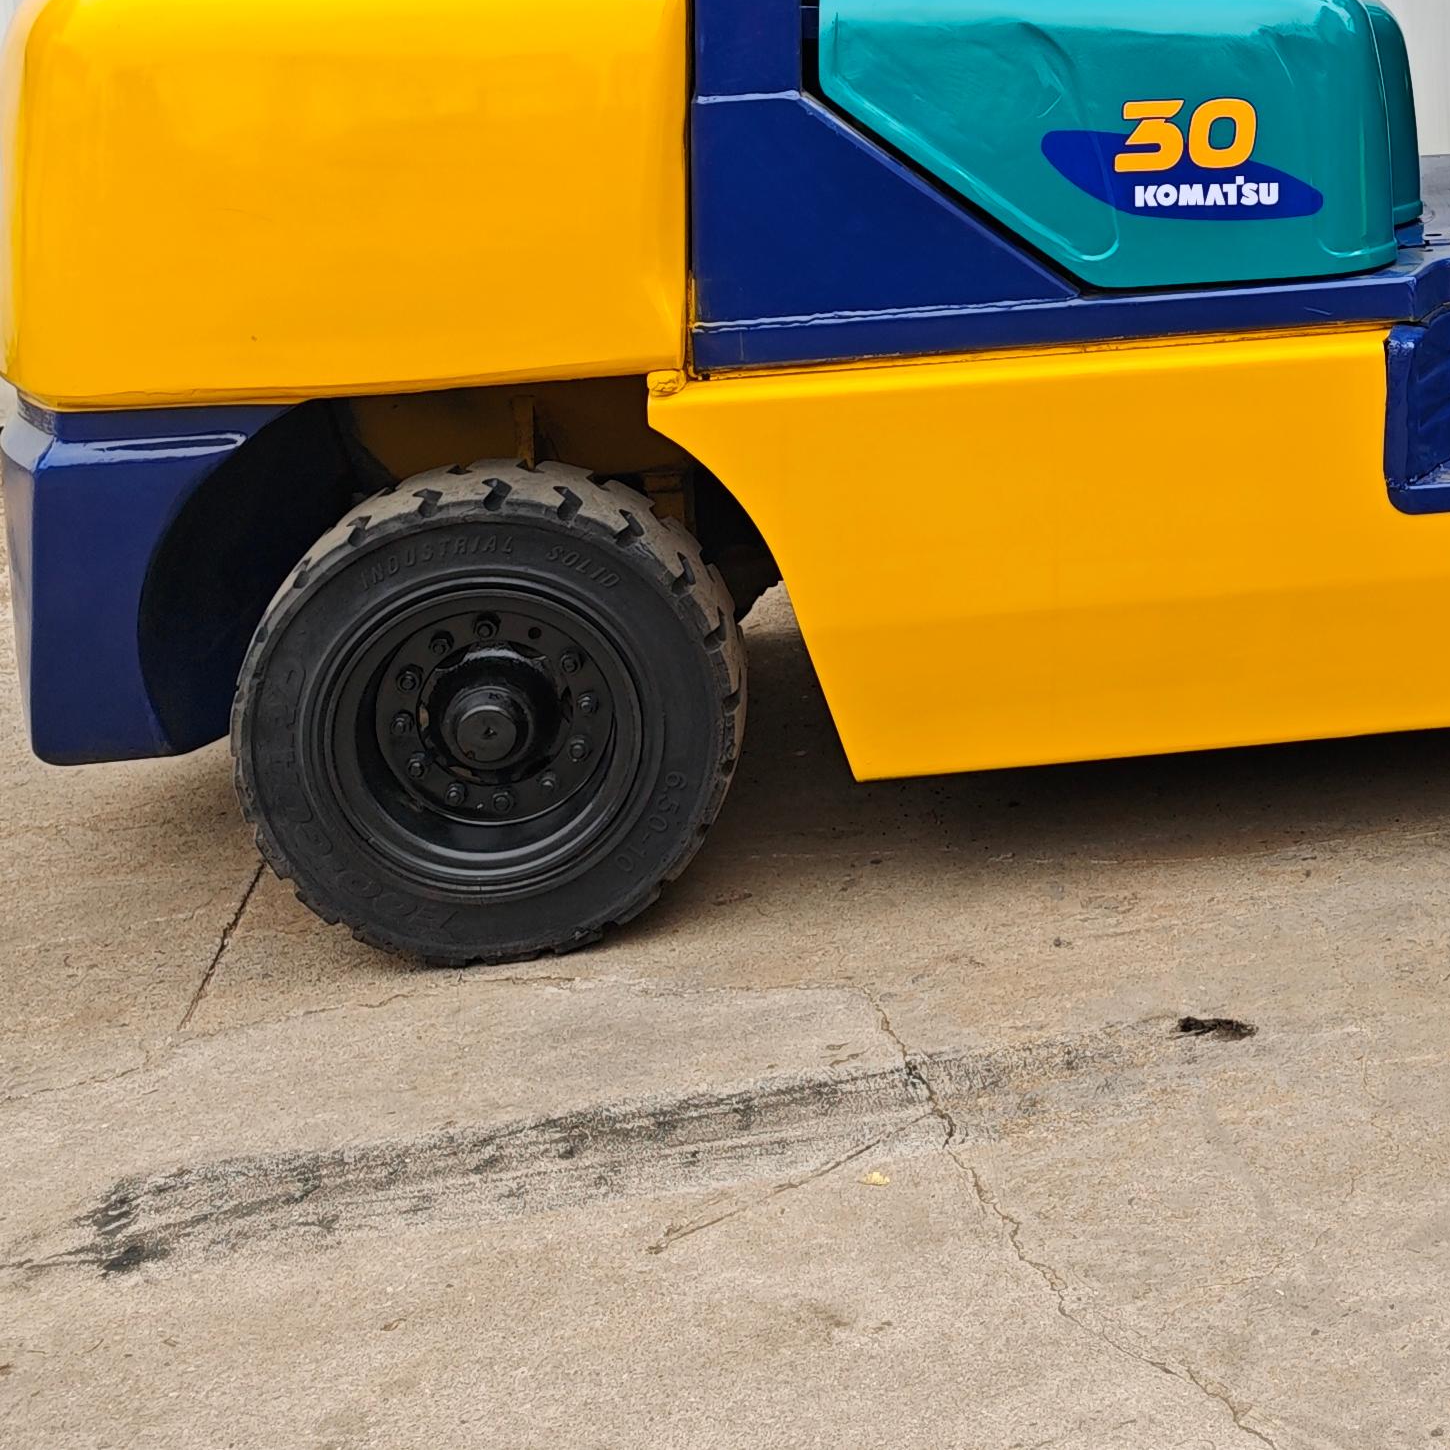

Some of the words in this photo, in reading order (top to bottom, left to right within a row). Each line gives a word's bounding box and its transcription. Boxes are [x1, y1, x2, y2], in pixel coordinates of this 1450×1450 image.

[1113, 97, 1257, 173] 30
[1134, 175, 1279, 208] KOMATSU
[359, 535, 514, 591] INDUSTRIAL
[545, 545, 622, 589] SOLID
